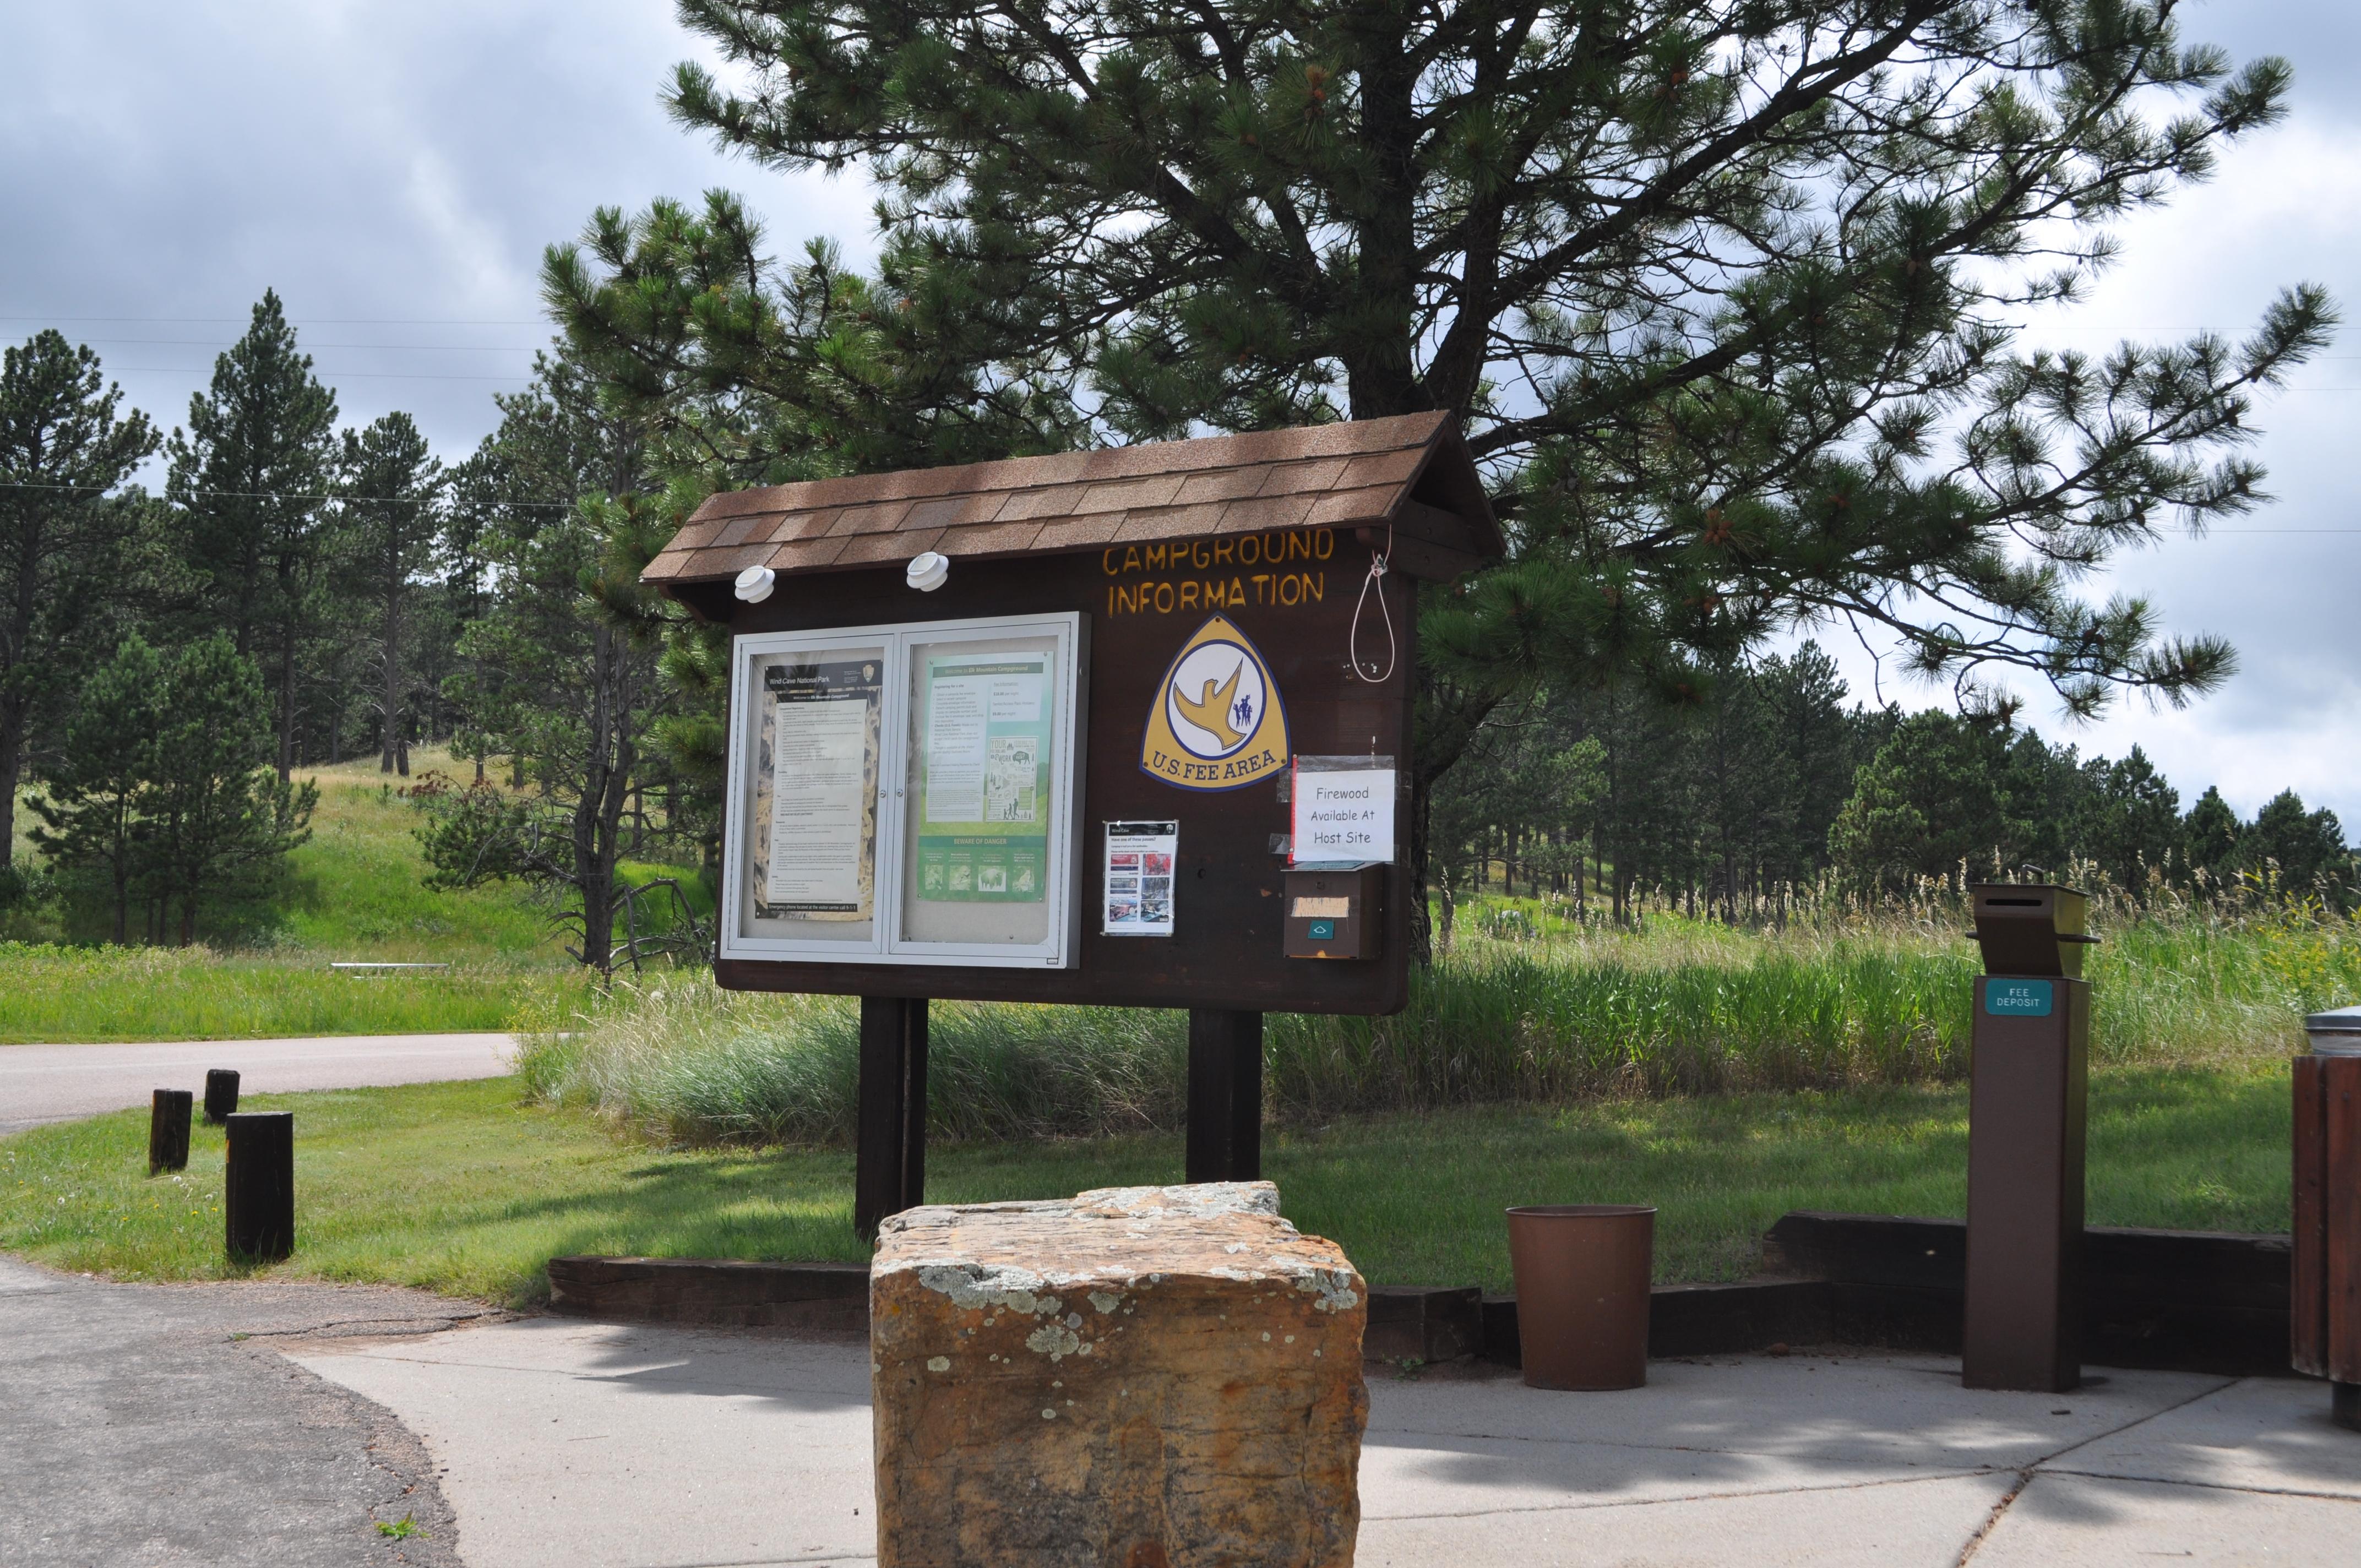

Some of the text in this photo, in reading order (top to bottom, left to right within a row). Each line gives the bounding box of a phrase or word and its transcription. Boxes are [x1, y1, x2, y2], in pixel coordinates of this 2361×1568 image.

[1102, 529, 1334, 576] CAMPGROUND
[1107, 572, 1324, 618] INFORMATION
[998, 665, 1028, 673] Campground
[991, 739, 1007, 749] YOUR
[1153, 749, 1276, 781] U.S. FEE AREA
[1316, 786, 1369, 800] Firewood
[1310, 809, 1375, 821] Available At
[1314, 831, 1371, 844] Host Site
[2009, 988, 2030, 997] FEE
[1996, 998, 2040, 1007] DEPOSIT
